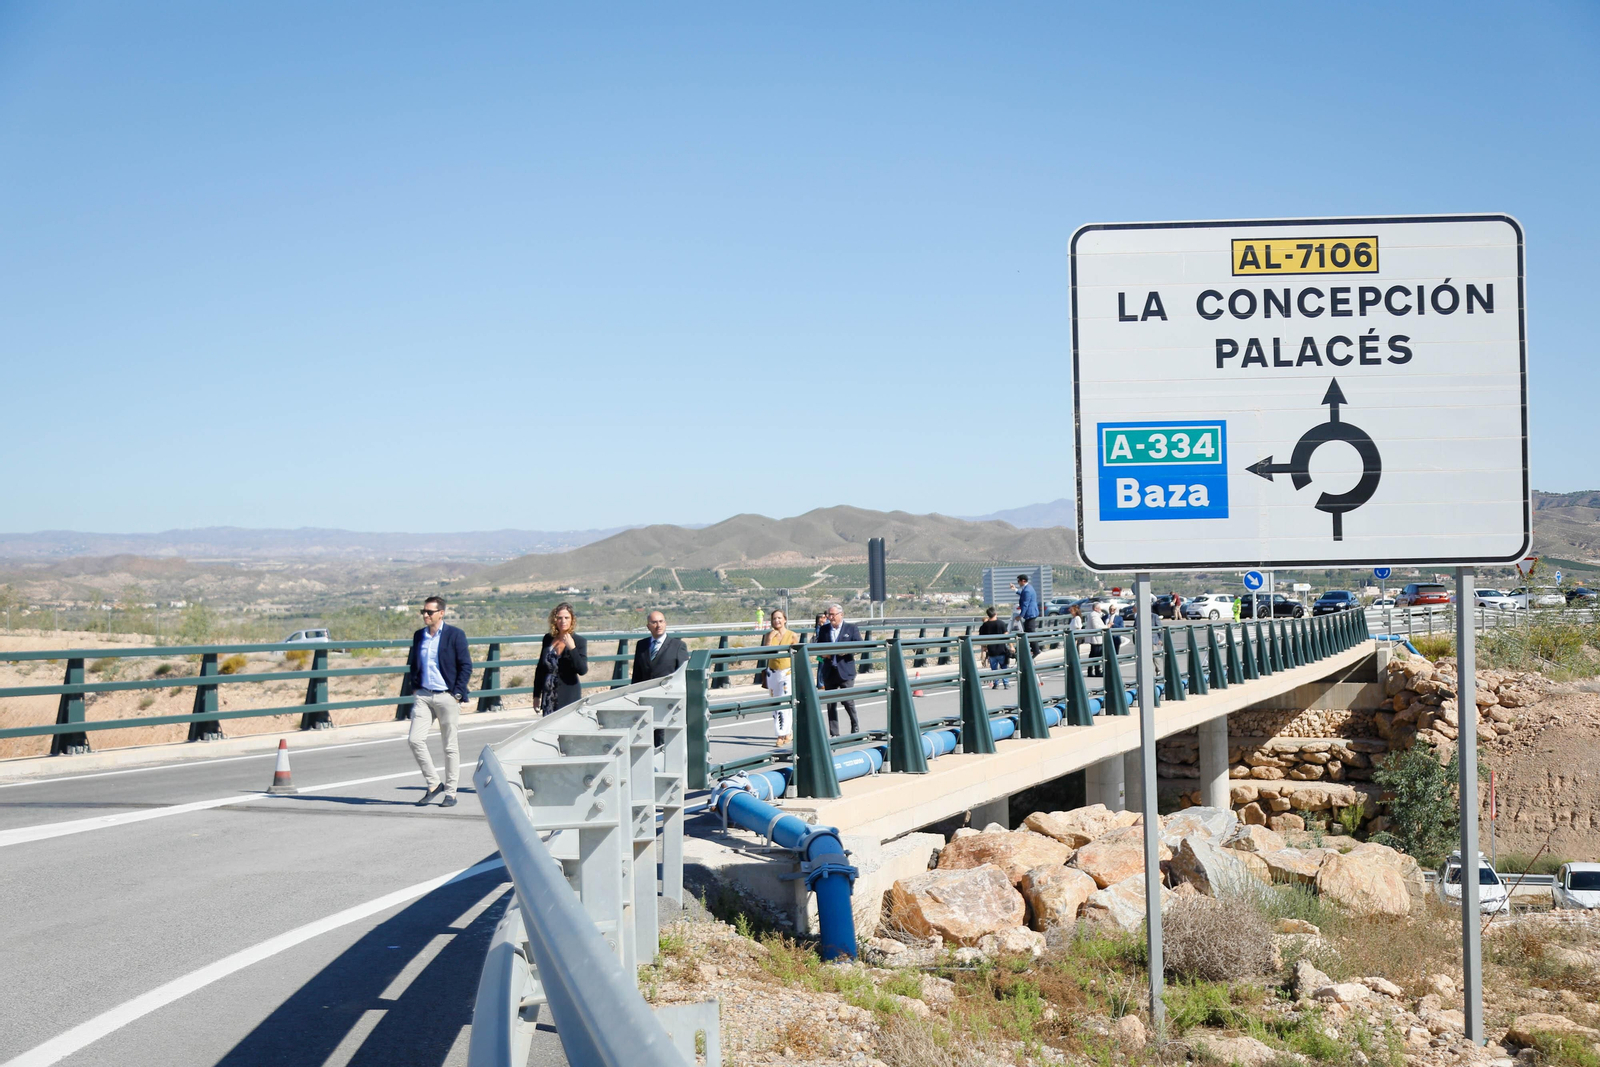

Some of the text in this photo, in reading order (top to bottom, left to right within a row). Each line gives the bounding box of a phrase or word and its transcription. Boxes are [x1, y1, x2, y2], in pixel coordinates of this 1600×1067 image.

[1239, 242, 1373, 270] AL-7106
[1118, 277, 1495, 322] LA CONCEPCIÓN
[1216, 327, 1413, 369] PALACÉS
[1110, 432, 1215, 460] A-334
[1116, 477, 1211, 509] Baza
